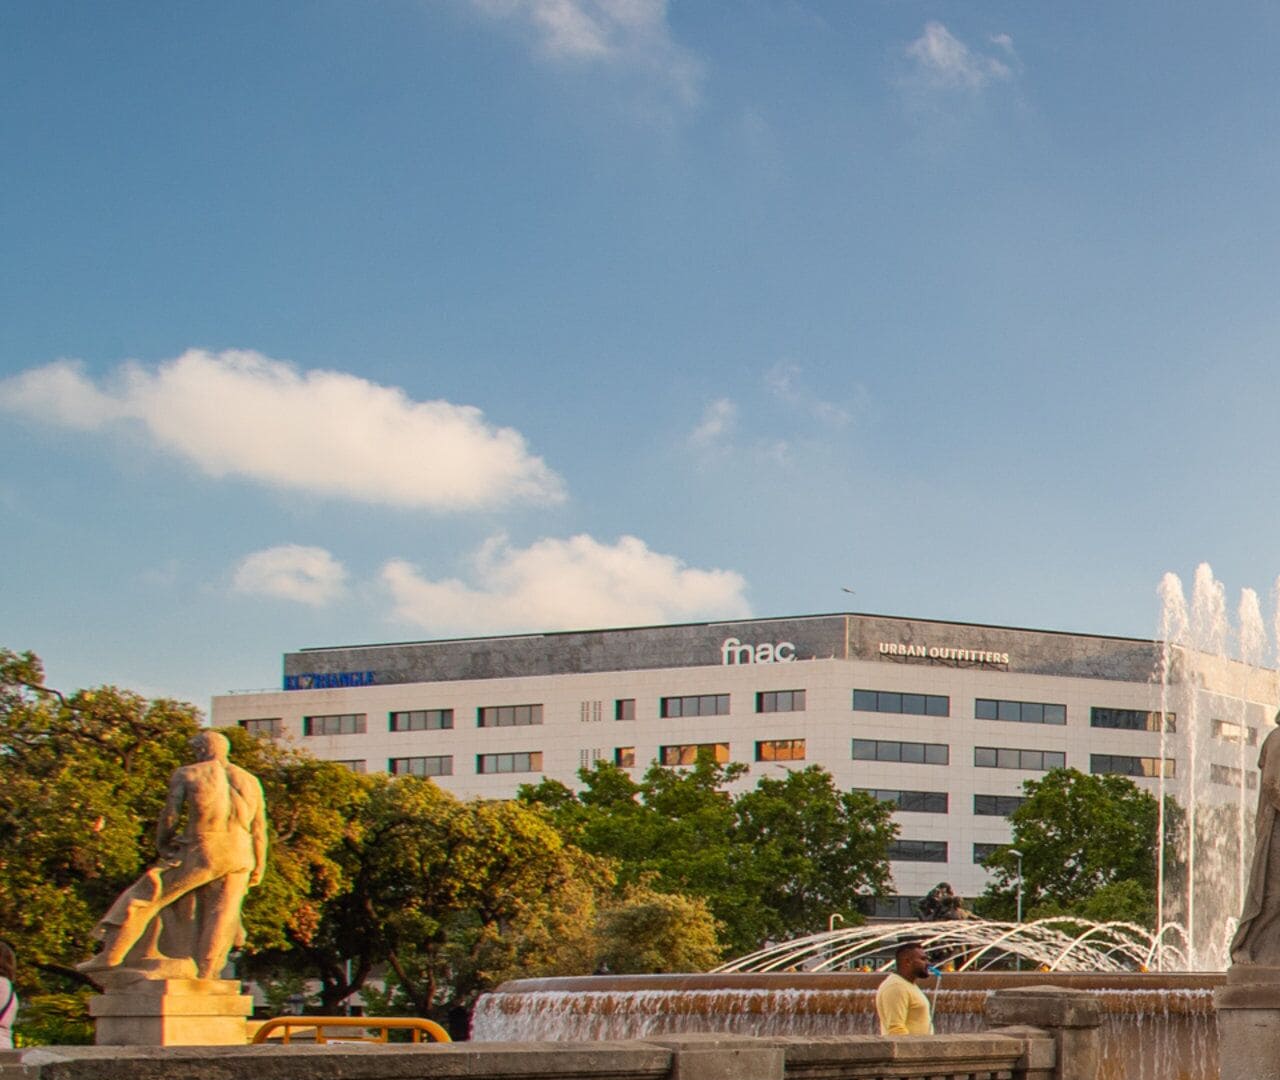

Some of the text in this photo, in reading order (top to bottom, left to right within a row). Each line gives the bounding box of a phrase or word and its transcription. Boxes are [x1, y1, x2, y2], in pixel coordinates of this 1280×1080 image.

[721, 637, 797, 666] fnac
[879, 642, 1009, 663] URBAN OUTFITTERS
